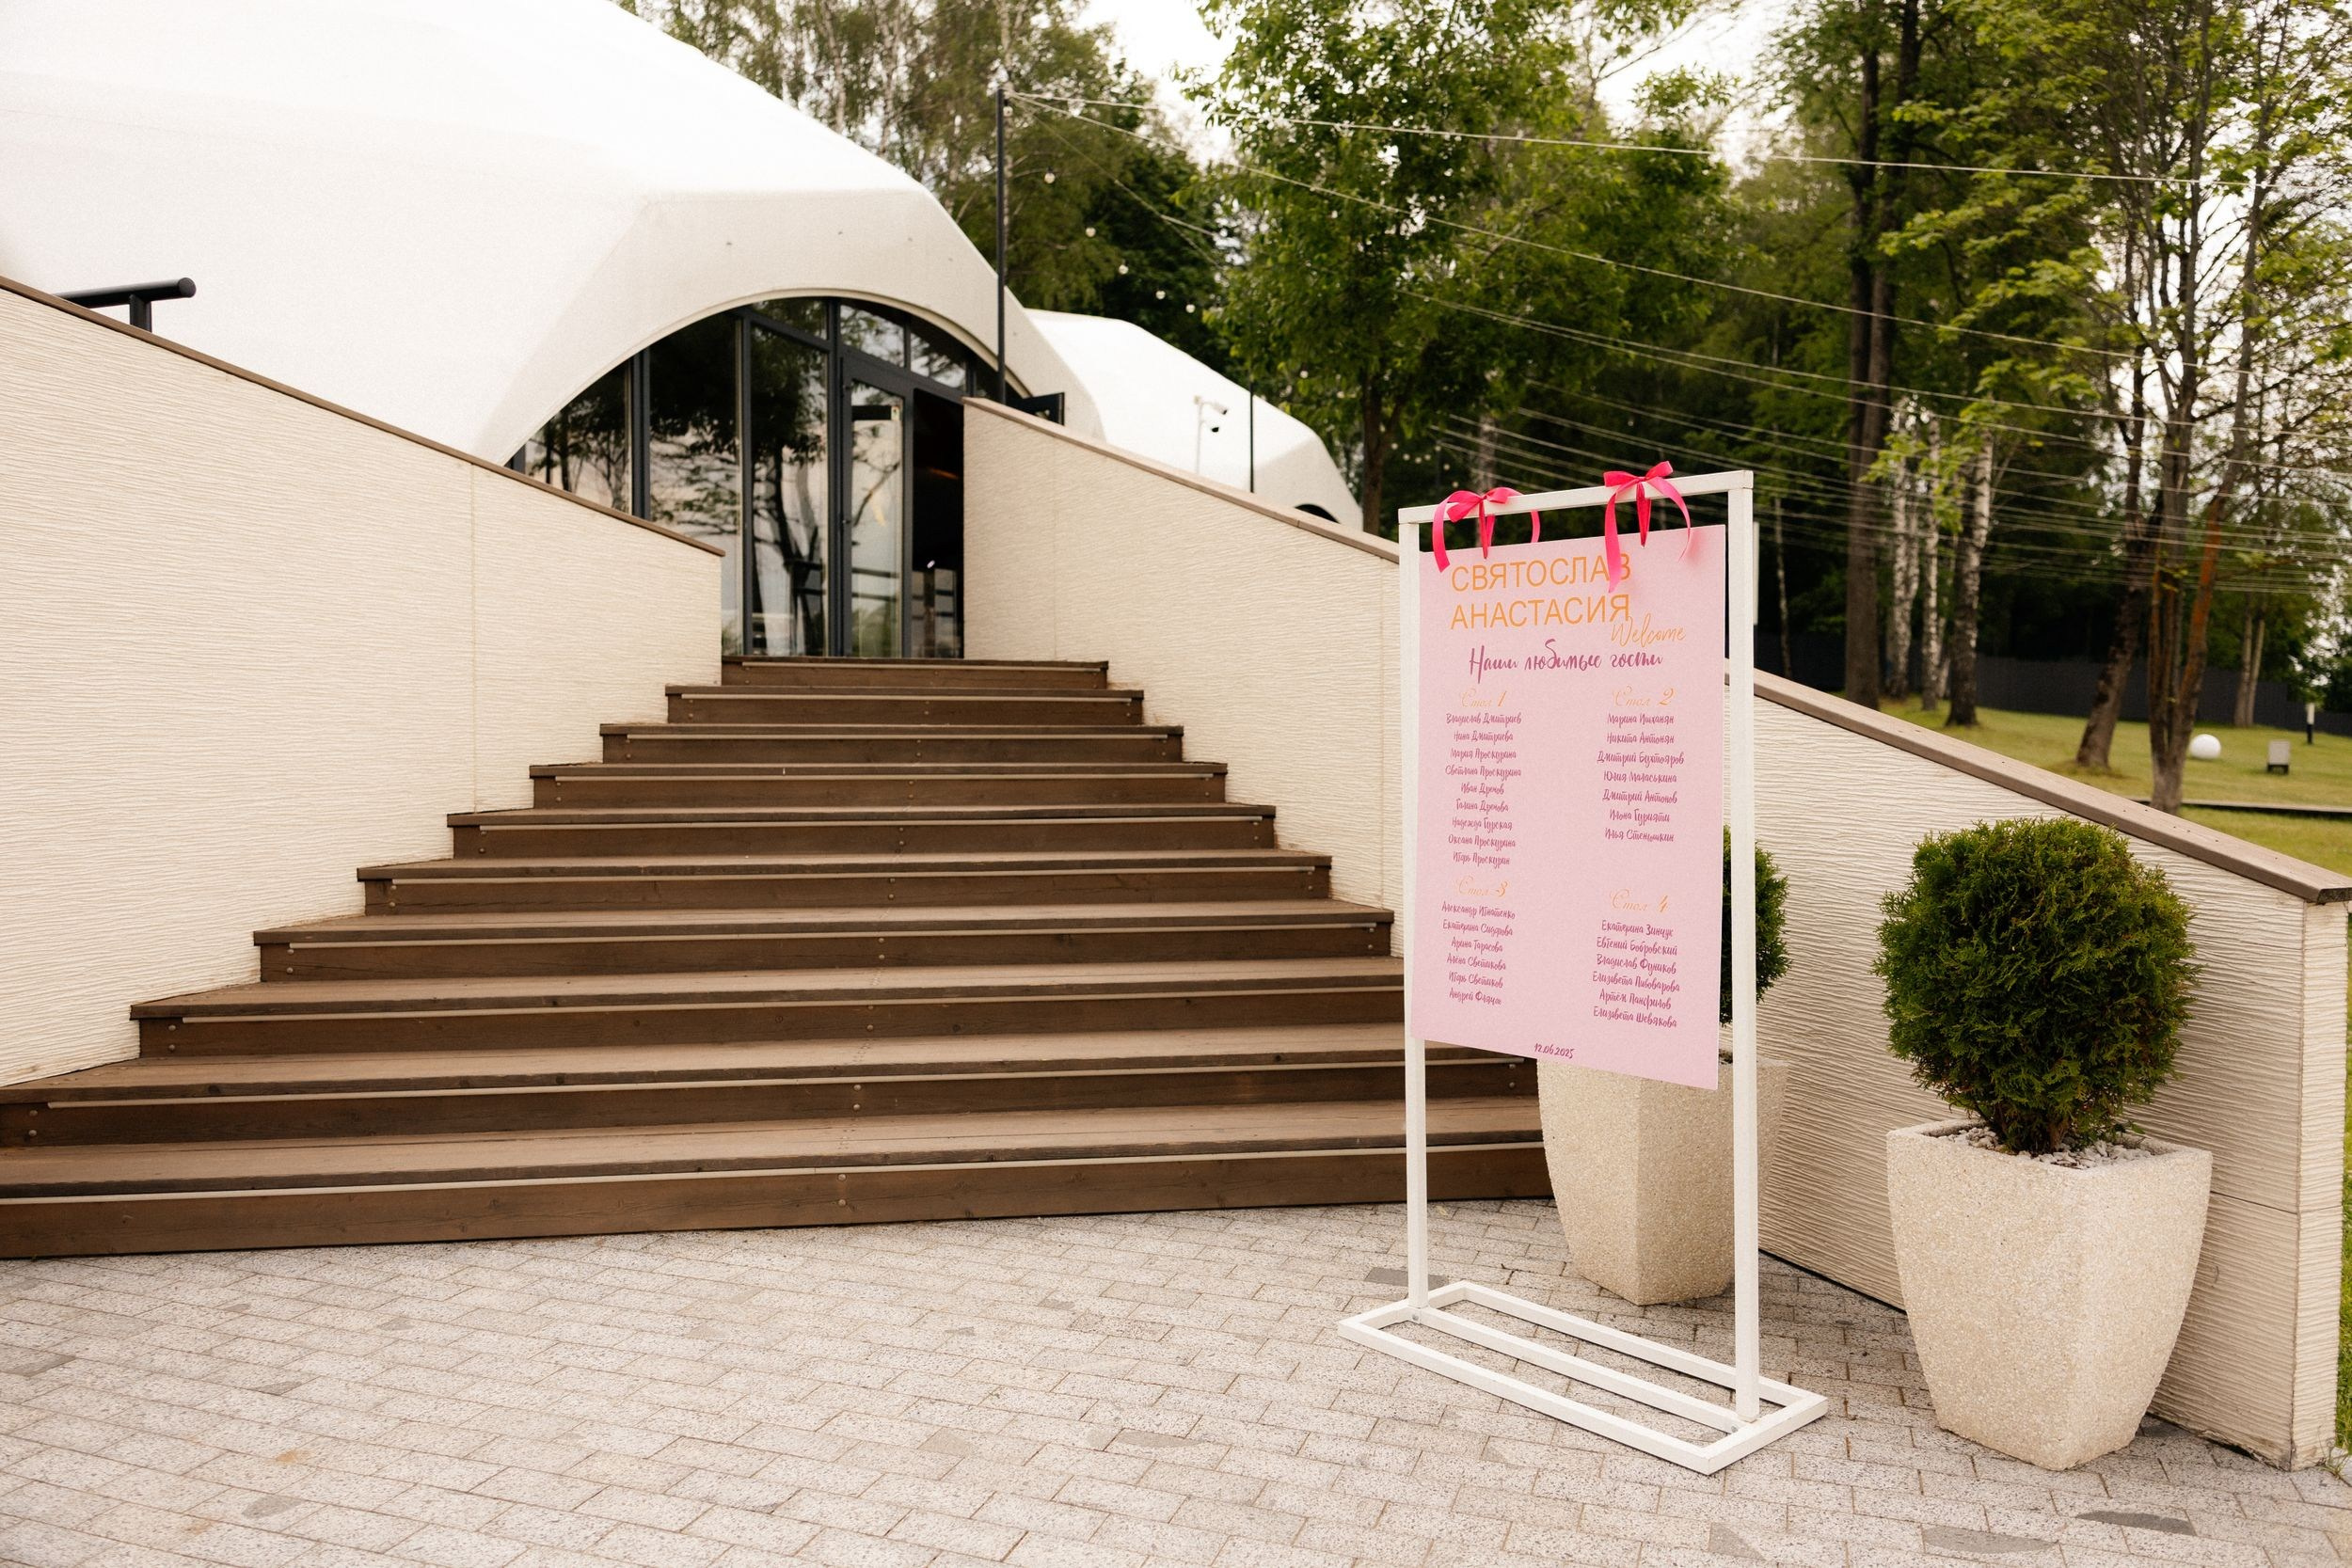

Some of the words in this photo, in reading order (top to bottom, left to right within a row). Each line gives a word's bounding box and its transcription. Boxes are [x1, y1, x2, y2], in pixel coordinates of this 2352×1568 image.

[1452, 553, 1630, 592] СВЯТОСЛАВ
[1451, 594, 1629, 630] АНАСТАСИЯ
[1611, 613, 1686, 647] Welcome
[1470, 645, 1518, 684] Наши
[1524, 638, 1601, 672] любимые
[1611, 650, 1663, 668] гости
[1498, 690, 1507, 707] 1
[1613, 686, 1650, 705] Стол
[1659, 688, 1675, 705] 2
[1446, 712, 1482, 726] Владислав
[1608, 713, 1637, 728] Марина
[1640, 713, 1674, 725] Ишханян
[1454, 730, 1470, 741] Нина
[1607, 732, 1637, 744] Никита
[1451, 748, 1472, 761] Мария
[1475, 749, 1517, 763] Проскурина
[1597, 751, 1636, 767] Дмитрий
[1445, 764, 1478, 775] Светлана
[1480, 766, 1521, 781] Проскурина
[1604, 770, 1627, 783] Юлия
[1461, 783, 1477, 794] Иван
[1456, 799, 1478, 810] Галина
[1602, 789, 1642, 805] Дмитрий
[1645, 790, 1677, 803] Антонов
[1610, 809, 1631, 820] Илона
[1453, 816, 1482, 831] Надежда
[1605, 828, 1624, 840] Илья
[1449, 834, 1472, 844] Оксана
[1475, 835, 1516, 851] Проскурина
[1453, 851, 1470, 864] Игорь
[1473, 853, 1510, 869] Проскурин
[1455, 875, 1489, 895] Стол
[1496, 881, 1509, 897] 3
[1610, 888, 1647, 911] Стол
[1659, 895, 1668, 912] 4
[1441, 901, 1477, 918] Александр
[1479, 905, 1515, 919] Игнатенко
[1443, 919, 1478, 933] Екатерина
[1601, 920, 1644, 936] Екатерина
[1452, 937, 1471, 951] Арина
[1474, 940, 1502, 954] Тарасова
[1597, 937, 1628, 950] Евгений
[1630, 940, 1677, 957] Бобровский
[1597, 954, 1637, 970] Владислав
[1449, 971, 1467, 985] Игорь
[1593, 972, 1632, 985] Елизавета
[1449, 988, 1473, 1004] Андрей
[1629, 993, 1671, 1010] Панфилов
[1594, 1006, 1634, 1021] Елизавета
